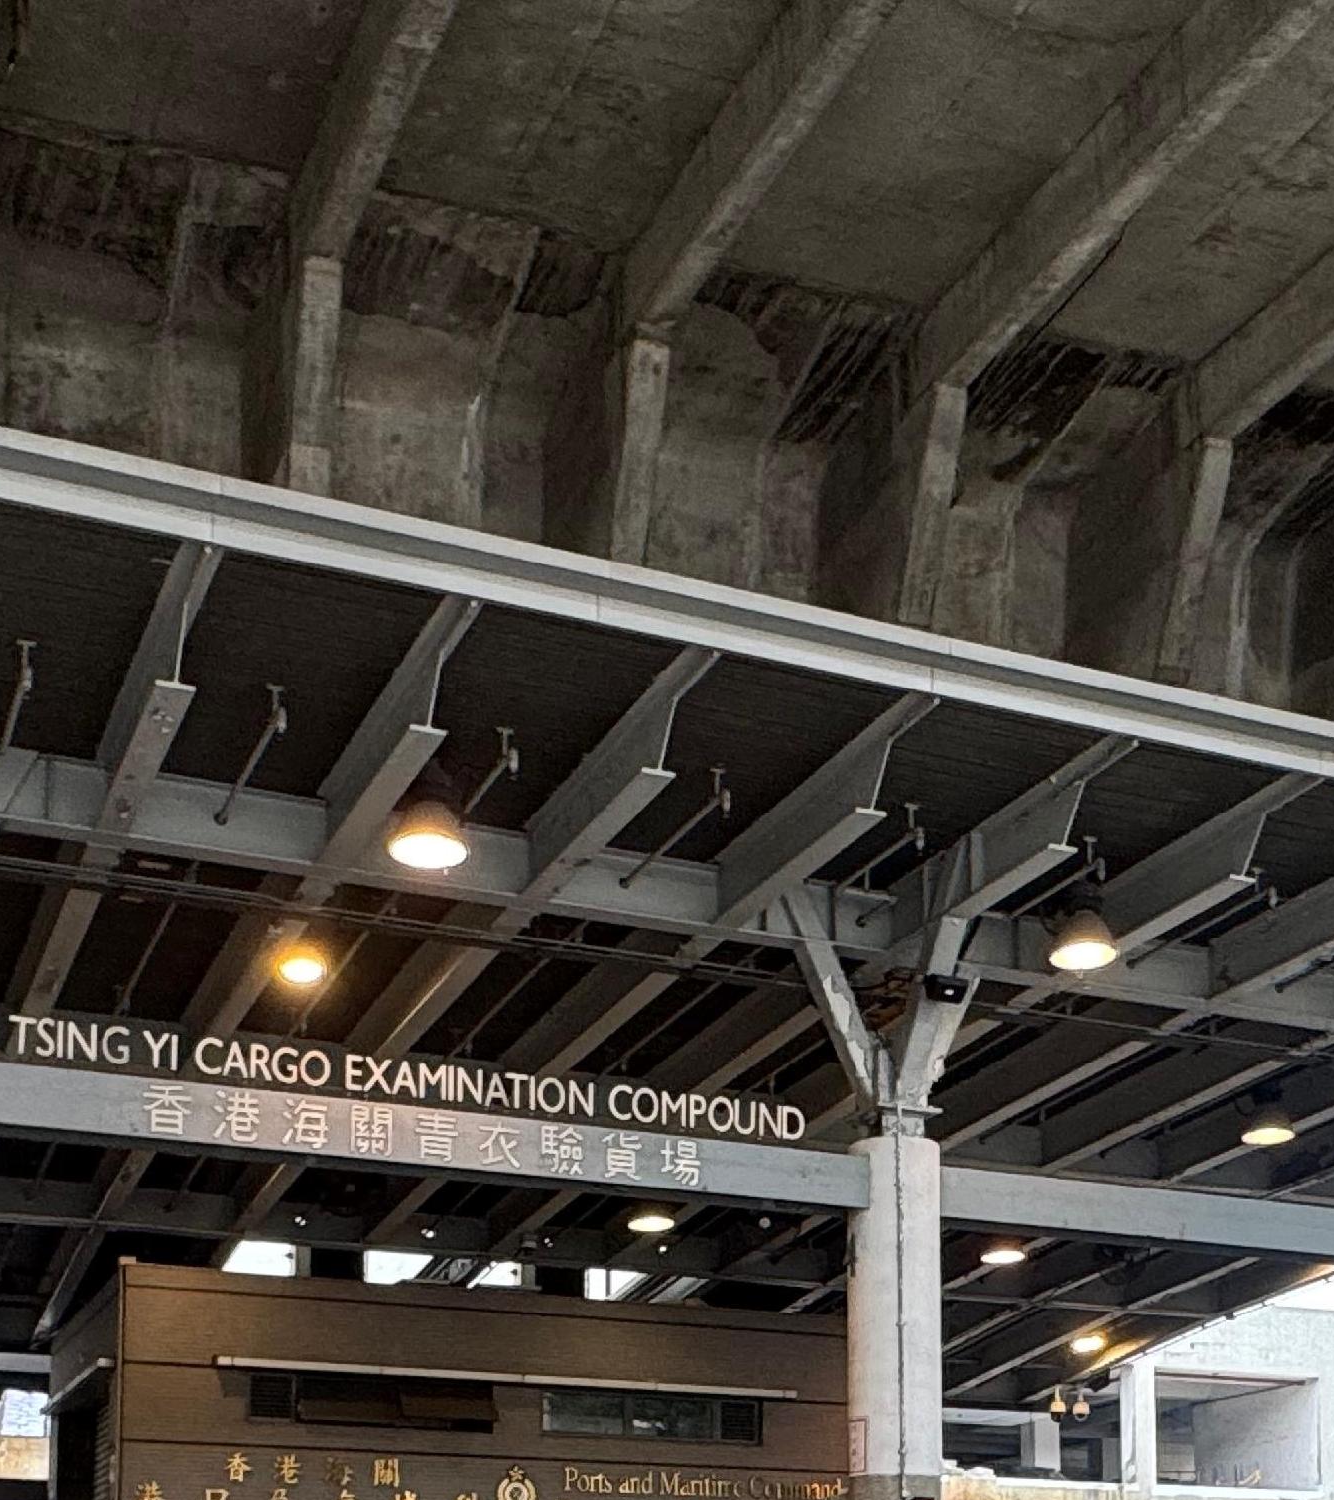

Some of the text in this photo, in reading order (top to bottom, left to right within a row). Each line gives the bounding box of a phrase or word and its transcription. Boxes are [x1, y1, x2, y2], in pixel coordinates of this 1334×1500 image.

[9, 1014, 806, 1141] TSING YI CARGO EXAMINATION COMPOUND
[143, 1085, 702, 1188] 香港海關青衣驗貨場
[564, 1466, 612, 1494] Ports
[619, 1471, 653, 1494] and
